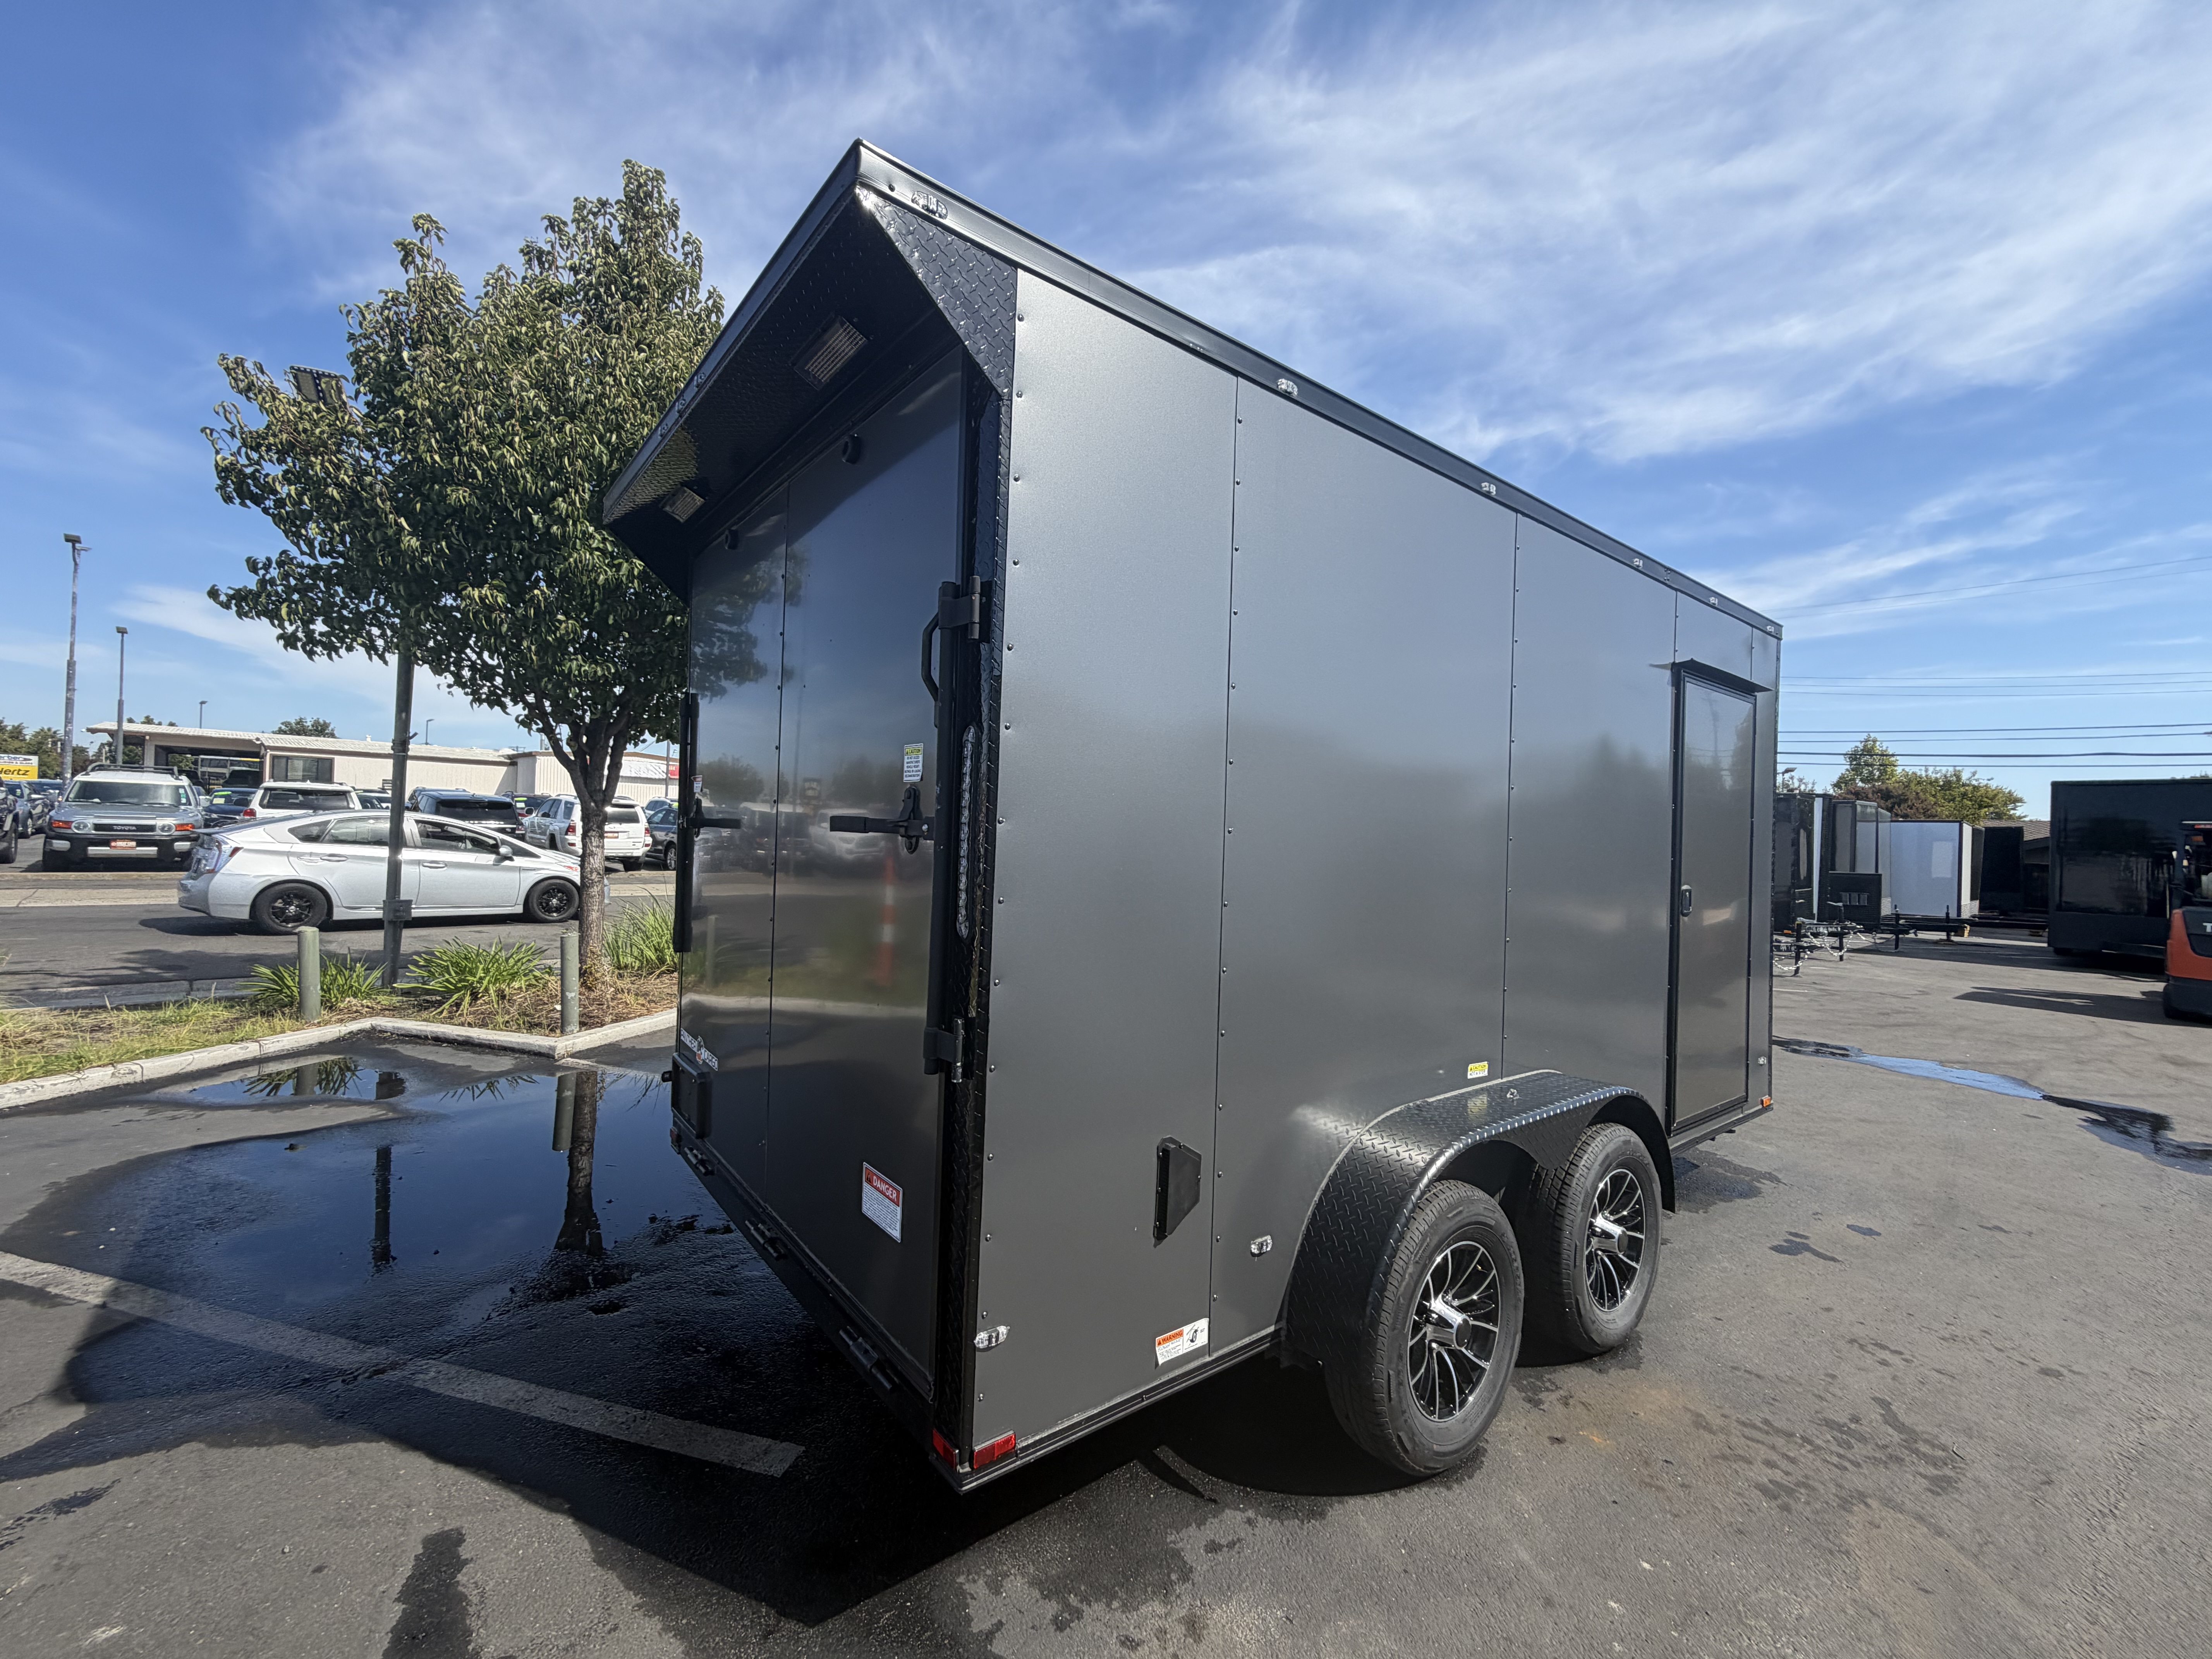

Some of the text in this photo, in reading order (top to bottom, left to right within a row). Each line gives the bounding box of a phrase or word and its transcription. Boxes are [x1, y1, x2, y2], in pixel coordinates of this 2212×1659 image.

[704, 1049, 717, 1069] CARGO
[873, 1175, 897, 1202] DANGER
[1161, 1329, 1183, 1343] WARNING
